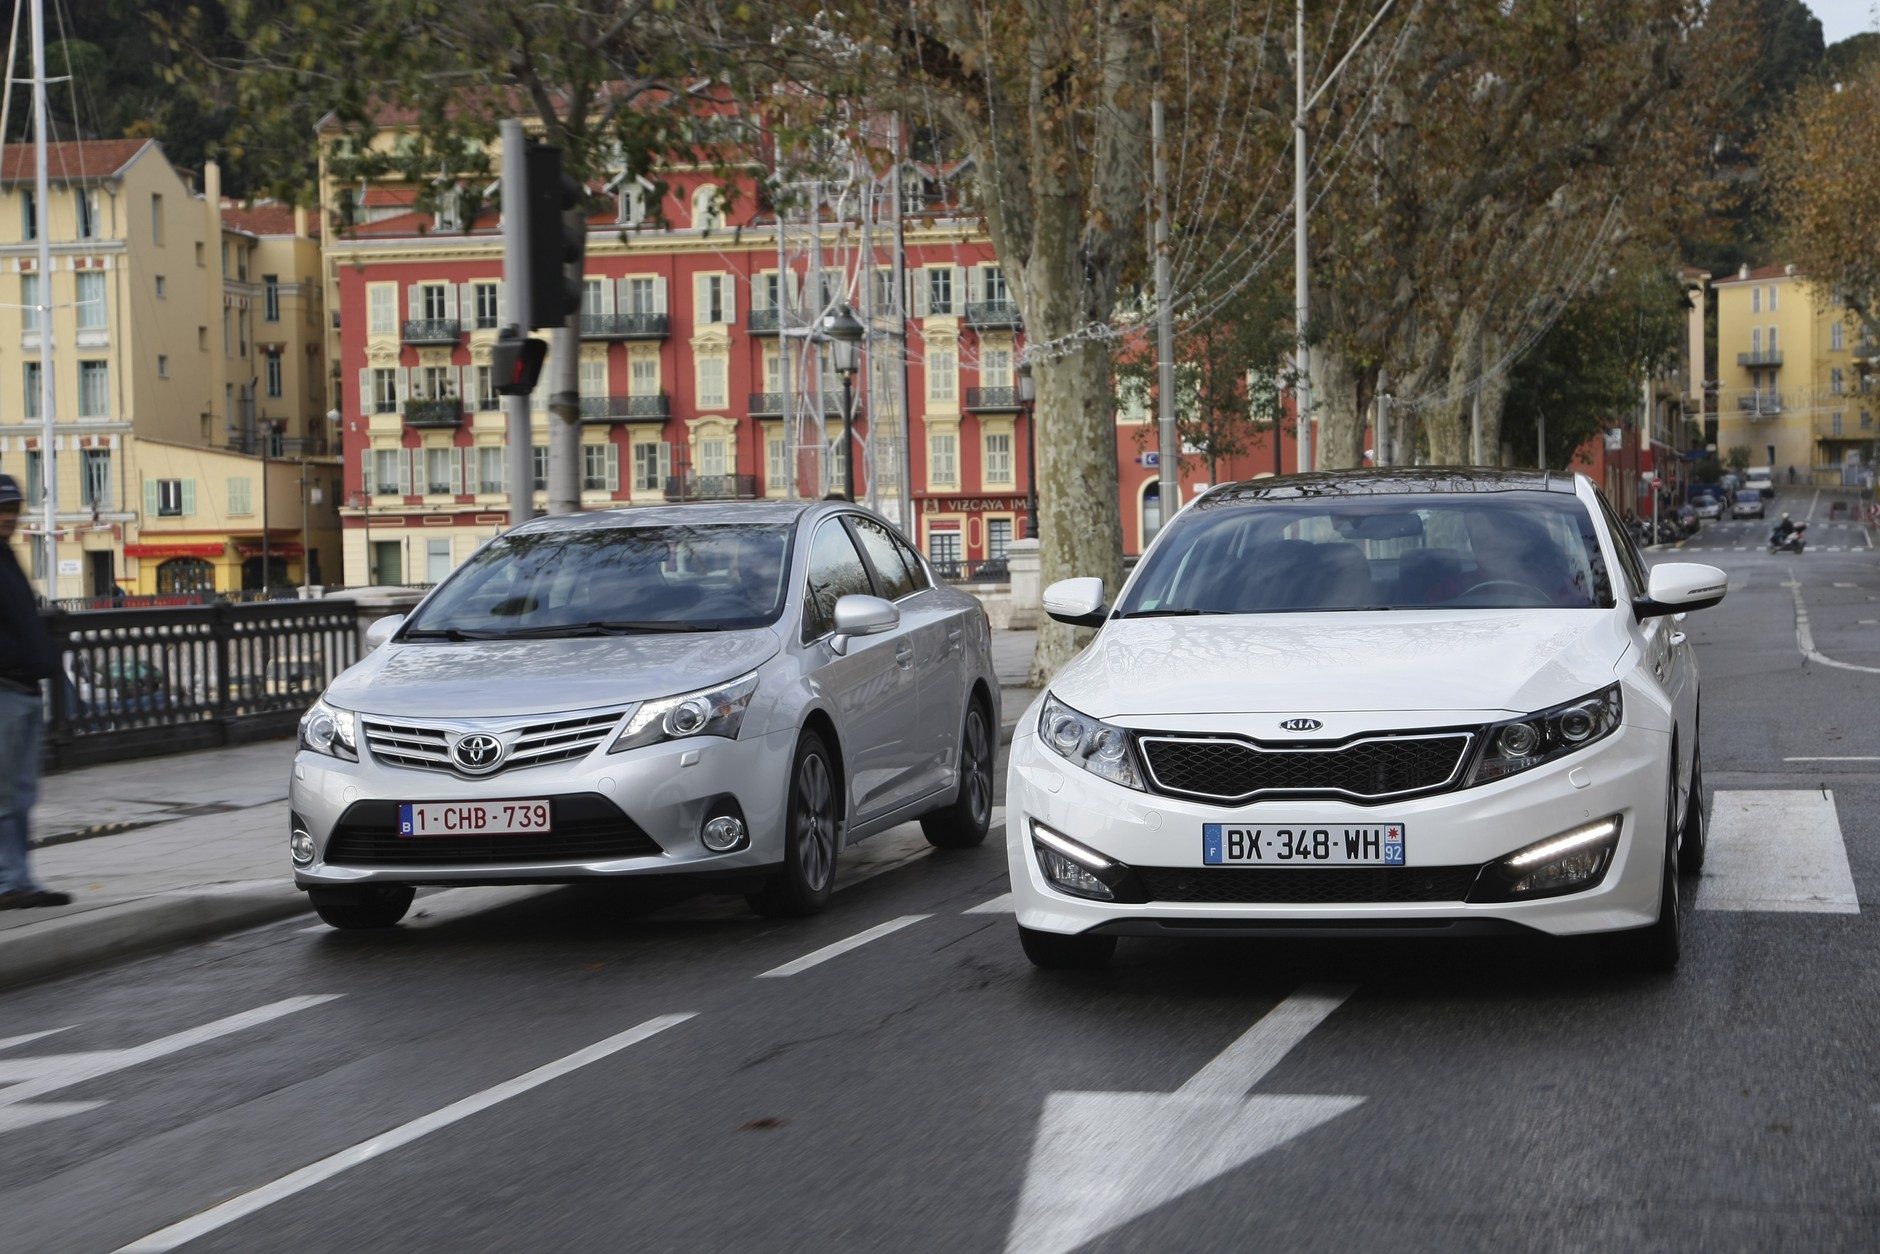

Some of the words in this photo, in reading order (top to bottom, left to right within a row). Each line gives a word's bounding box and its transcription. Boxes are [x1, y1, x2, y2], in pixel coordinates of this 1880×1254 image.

[947, 499, 1004, 511] VIZCAYA
[1286, 720, 1316, 728] KIA
[417, 805, 547, 830] 1-CHB-739
[402, 822, 411, 832] B
[1228, 829, 1380, 860] BX-348-WH
[1210, 847, 1216, 856] F
[1385, 845, 1402, 860] 92
